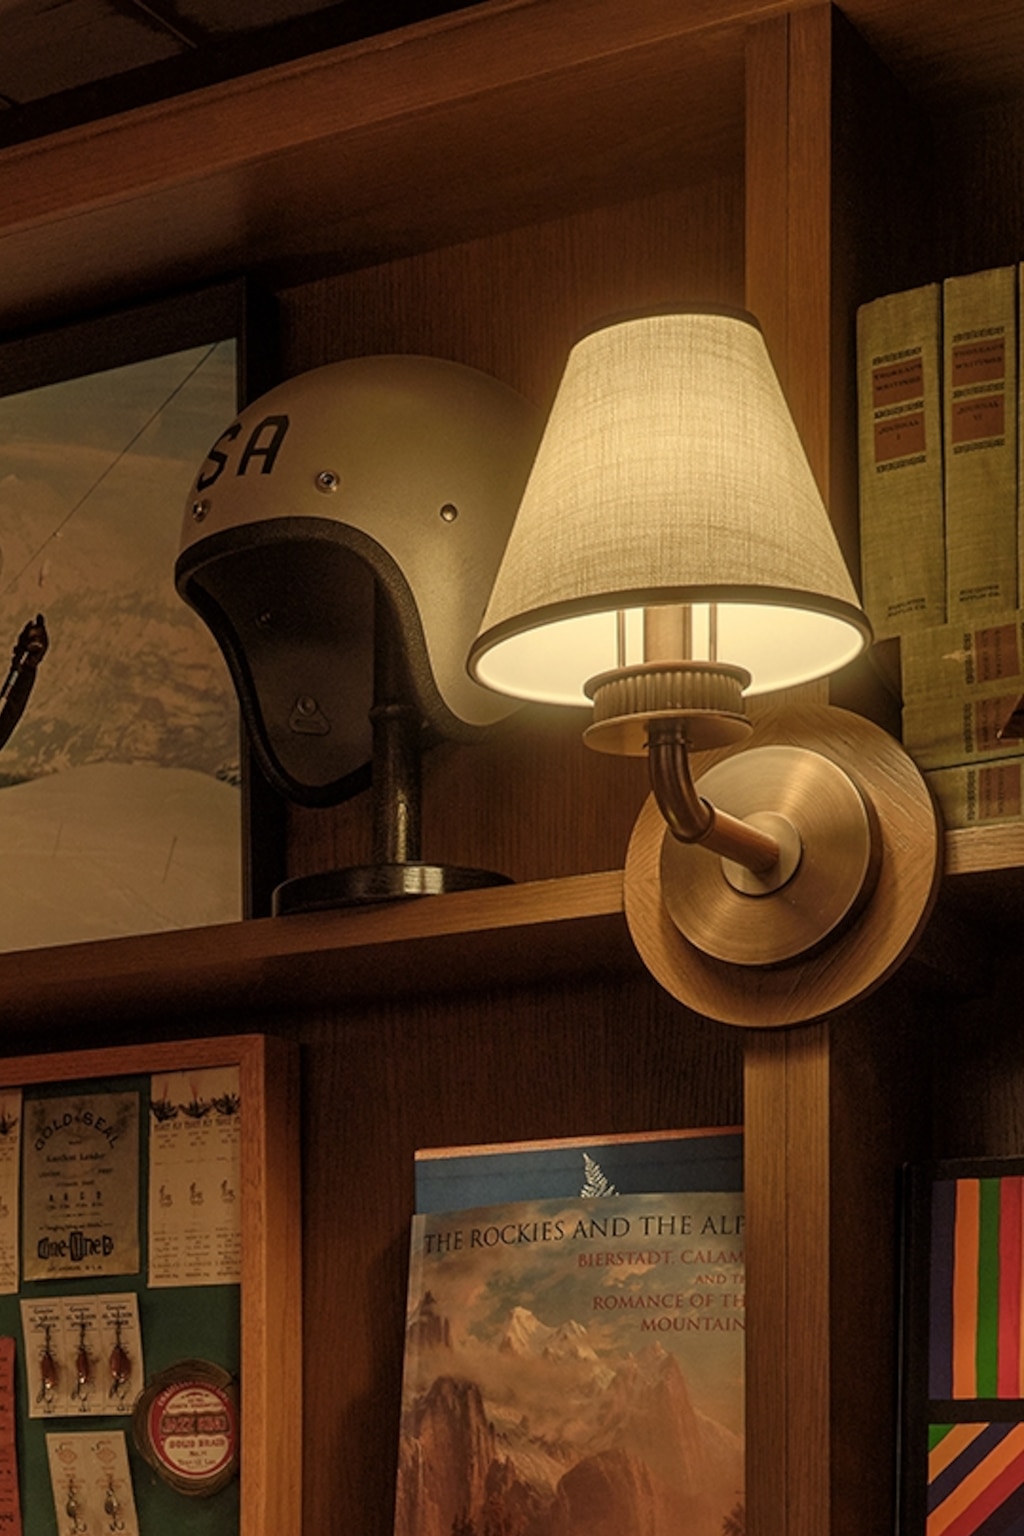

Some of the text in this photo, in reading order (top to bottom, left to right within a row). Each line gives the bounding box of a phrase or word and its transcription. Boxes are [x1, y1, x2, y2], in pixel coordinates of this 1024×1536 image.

[35, 1113, 73, 1151] GOLD
[83, 1111, 118, 1149] SEAL
[424, 1233, 464, 1254] THE
[470, 1220, 565, 1248] ROCKIES
[572, 1216, 631, 1239] AND
[639, 1215, 692, 1236] THE
[694, 1274, 726, 1285] AND
[593, 1295, 684, 1311] ROMANCE
[689, 1294, 714, 1308] OF
